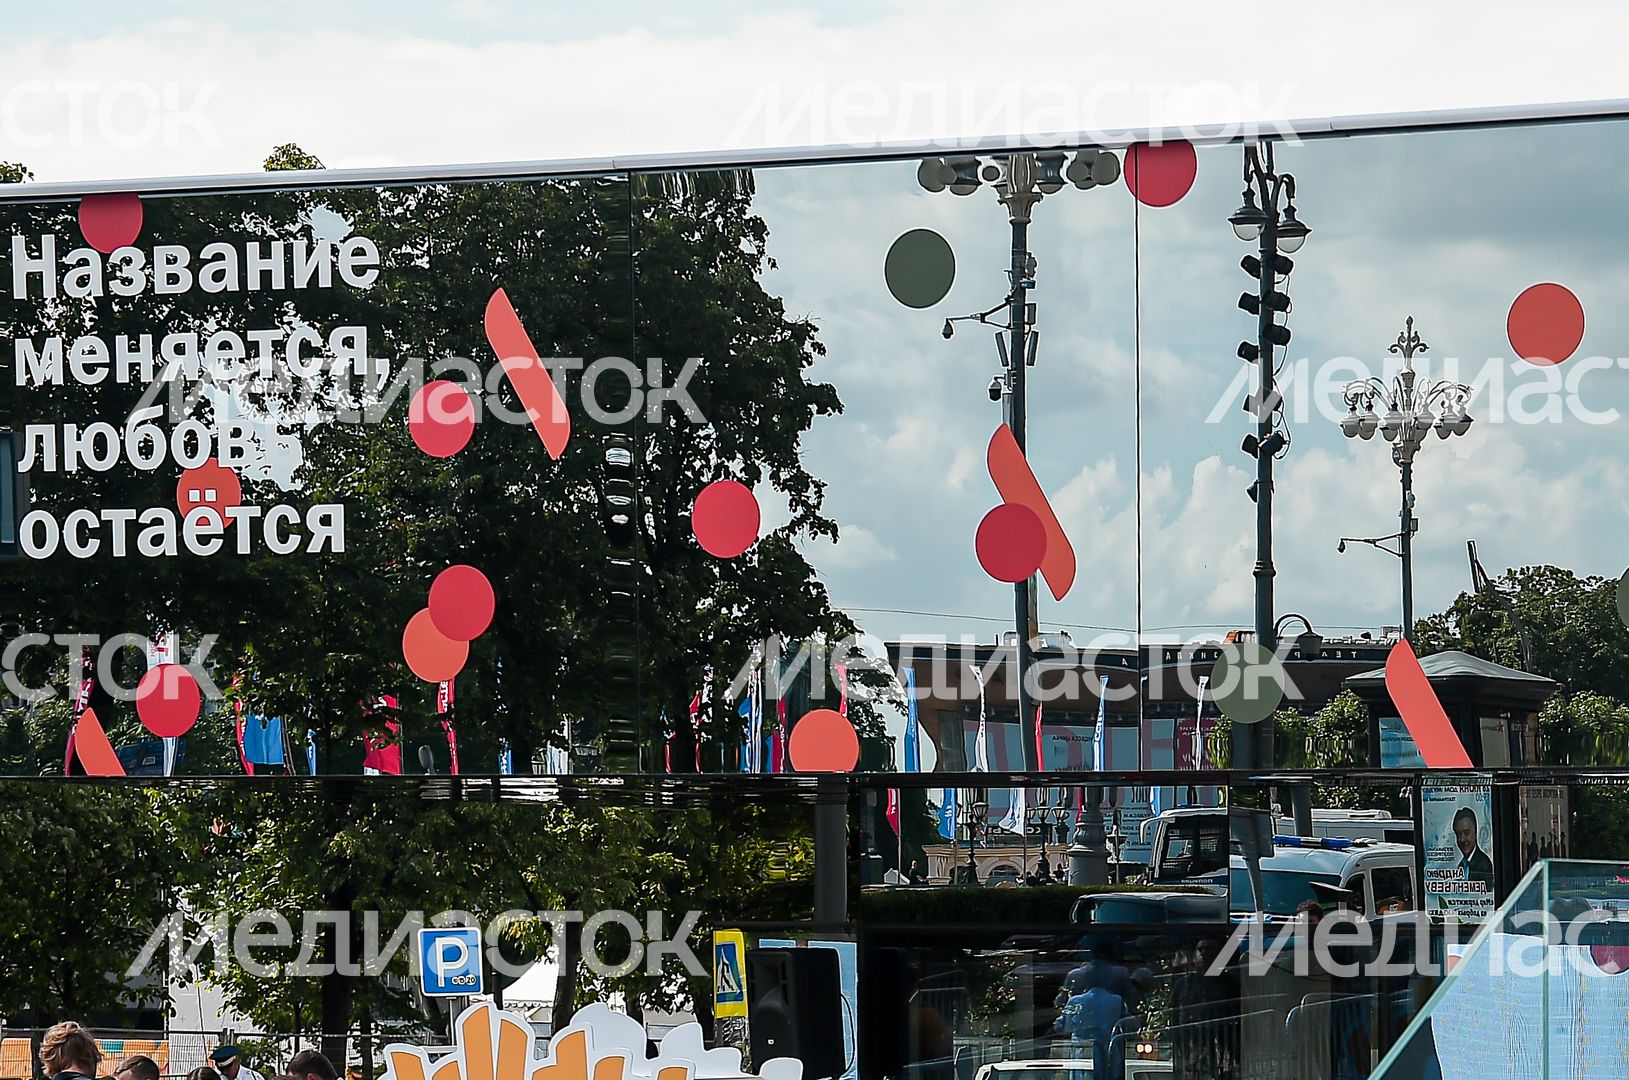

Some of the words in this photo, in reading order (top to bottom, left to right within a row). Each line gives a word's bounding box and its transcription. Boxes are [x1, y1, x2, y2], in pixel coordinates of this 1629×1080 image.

[11, 233, 381, 300] Название
[14, 325, 391, 390] меняется,
[18, 488, 347, 560] остаётся
